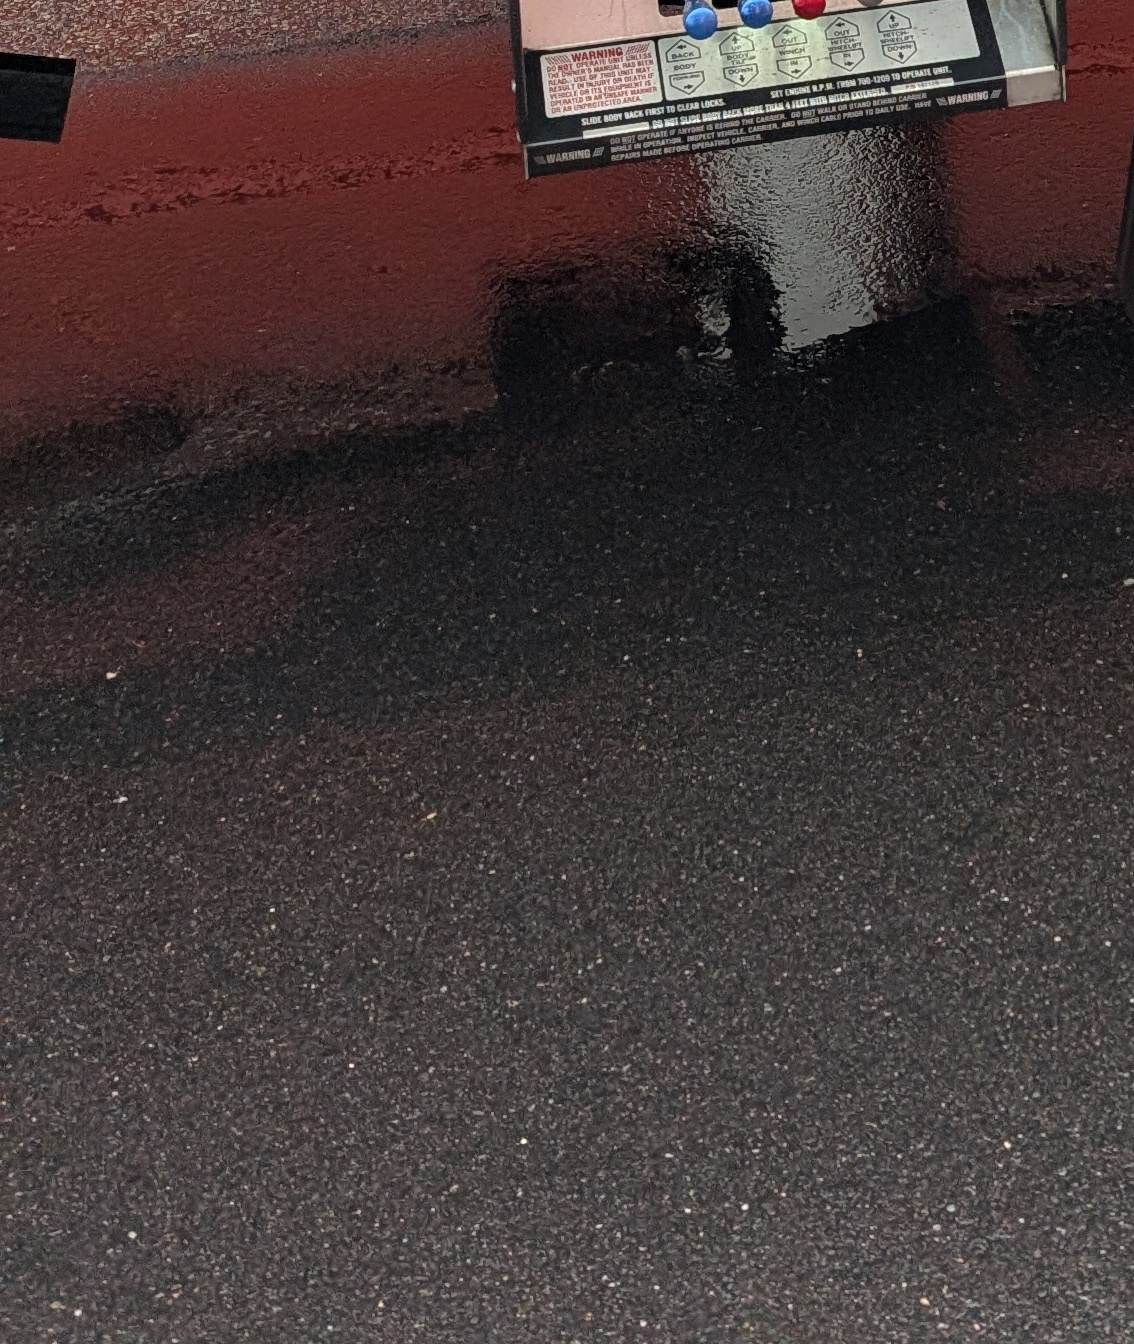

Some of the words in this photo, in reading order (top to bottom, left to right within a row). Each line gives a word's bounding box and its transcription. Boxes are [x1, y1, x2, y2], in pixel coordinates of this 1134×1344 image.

[571, 47, 624, 63] WARNING
[671, 51, 695, 60] BACK
[673, 62, 697, 71] BODY
[947, 90, 989, 106] WARNING
[603, 112, 623, 123] BODY
[624, 110, 644, 121] BACK
[546, 148, 591, 165] WARNING
